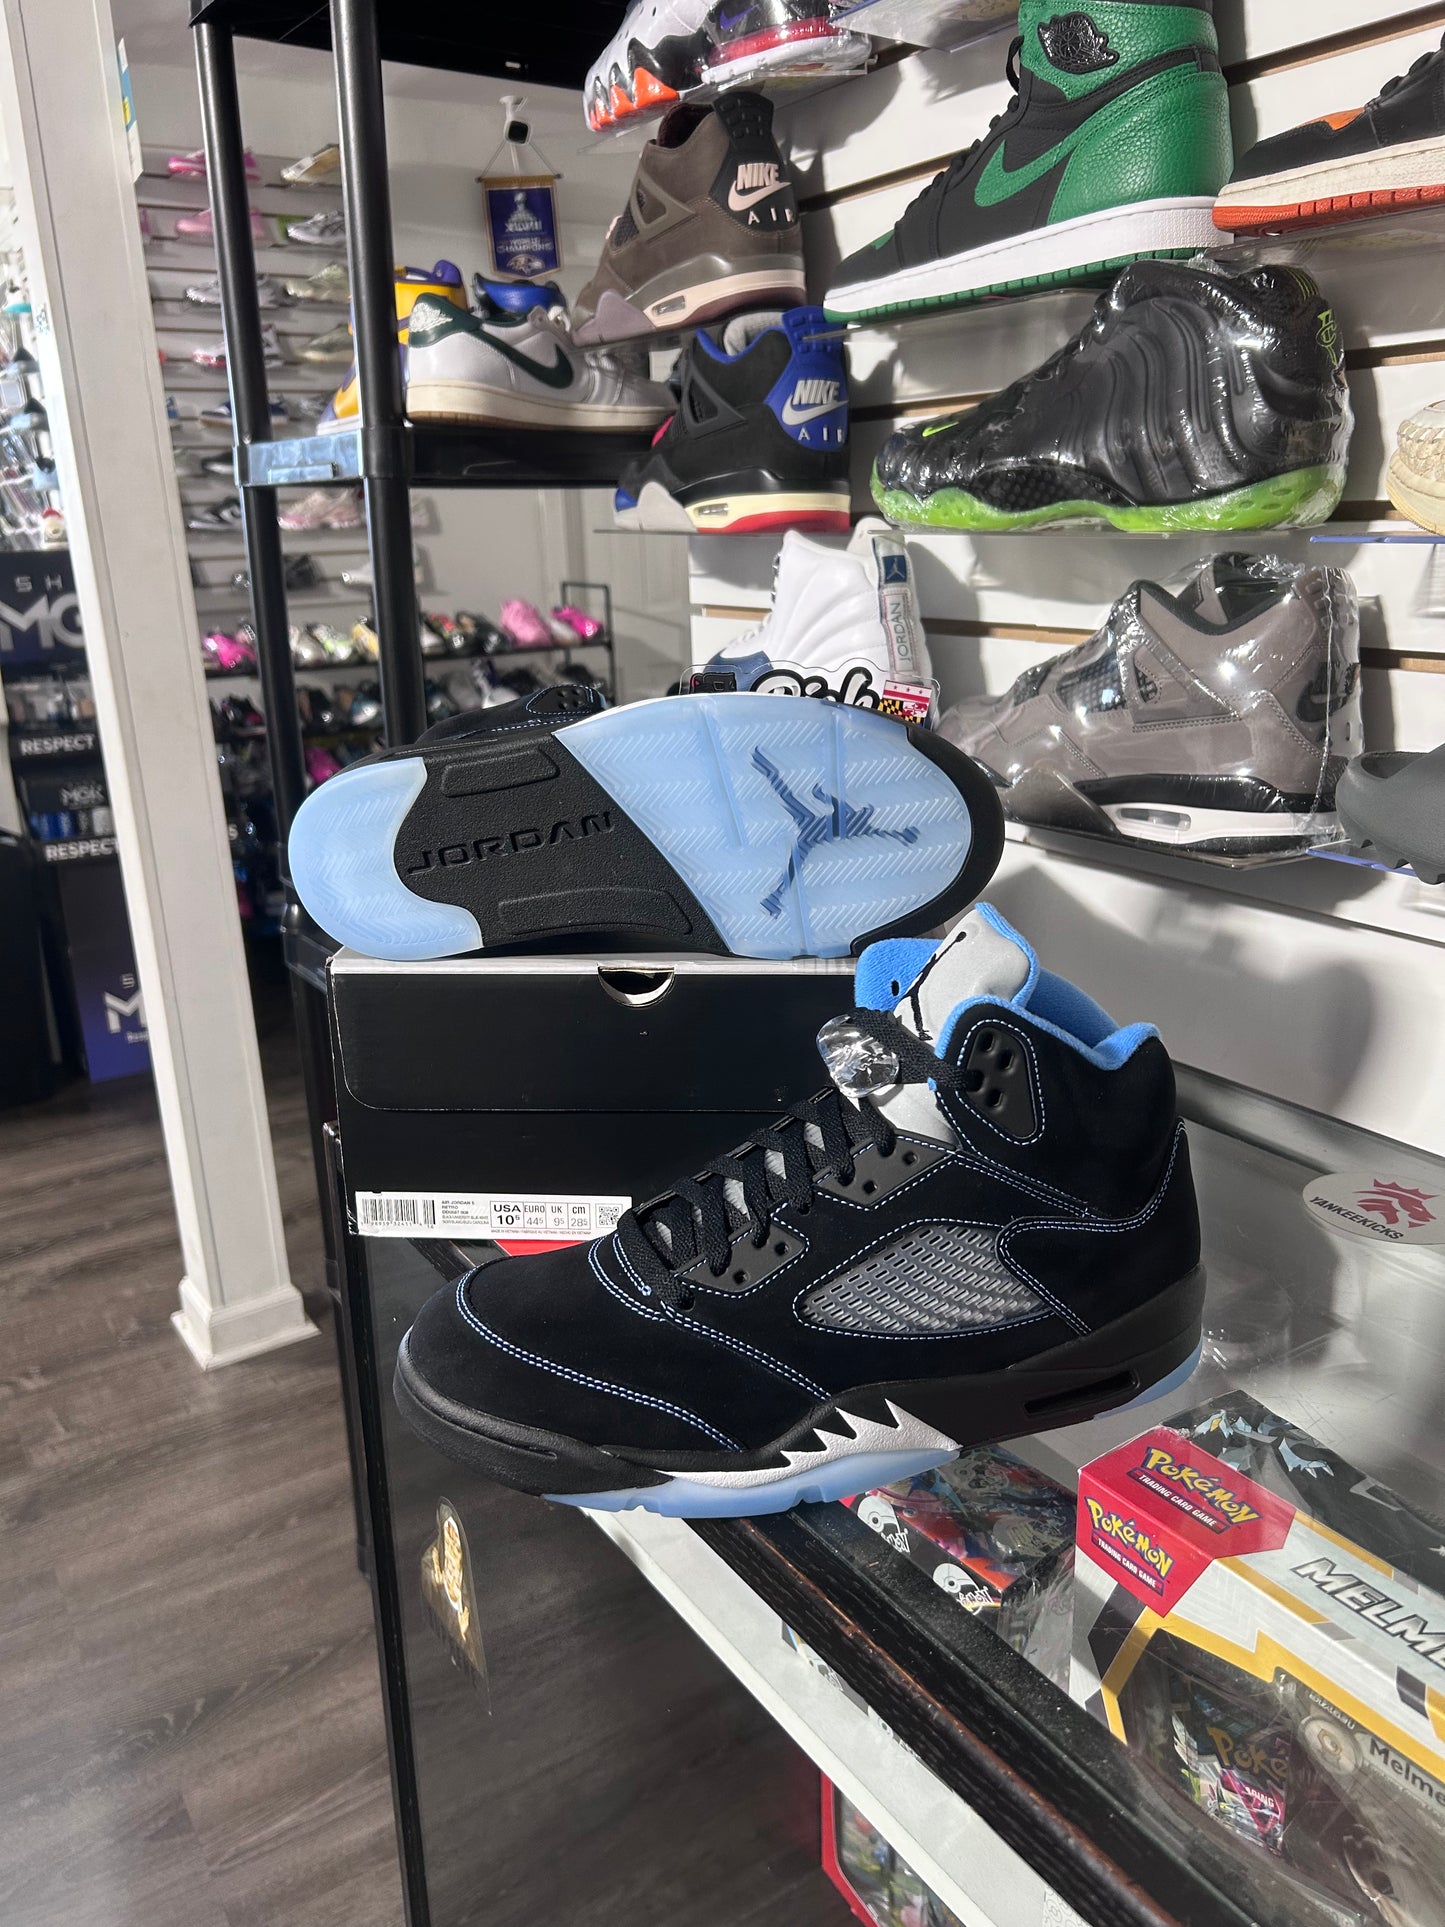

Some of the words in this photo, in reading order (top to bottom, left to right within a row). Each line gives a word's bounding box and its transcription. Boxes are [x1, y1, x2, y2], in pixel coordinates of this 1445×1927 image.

[737, 163, 779, 191] NIKE
[792, 379, 841, 406] NIKE
[889, 602, 912, 662] JORDAN
[20, 733, 96, 756] RESPECT
[407, 811, 615, 876] JORDAN
[493, 1204, 521, 1213] USA
[524, 1205, 545, 1213] EURO
[551, 1206, 563, 1214] UK
[572, 1206, 586, 1215] cm
[1309, 1196, 1405, 1240] YANKEEKICKS
[1138, 1474, 1171, 1498] TRADING
[1170, 1495, 1193, 1512] CARD
[1191, 1508, 1217, 1528] GAME
[1098, 1538, 1122, 1562] TRADING
[1121, 1556, 1139, 1576] CARD
[1138, 1570, 1157, 1589] GAME
